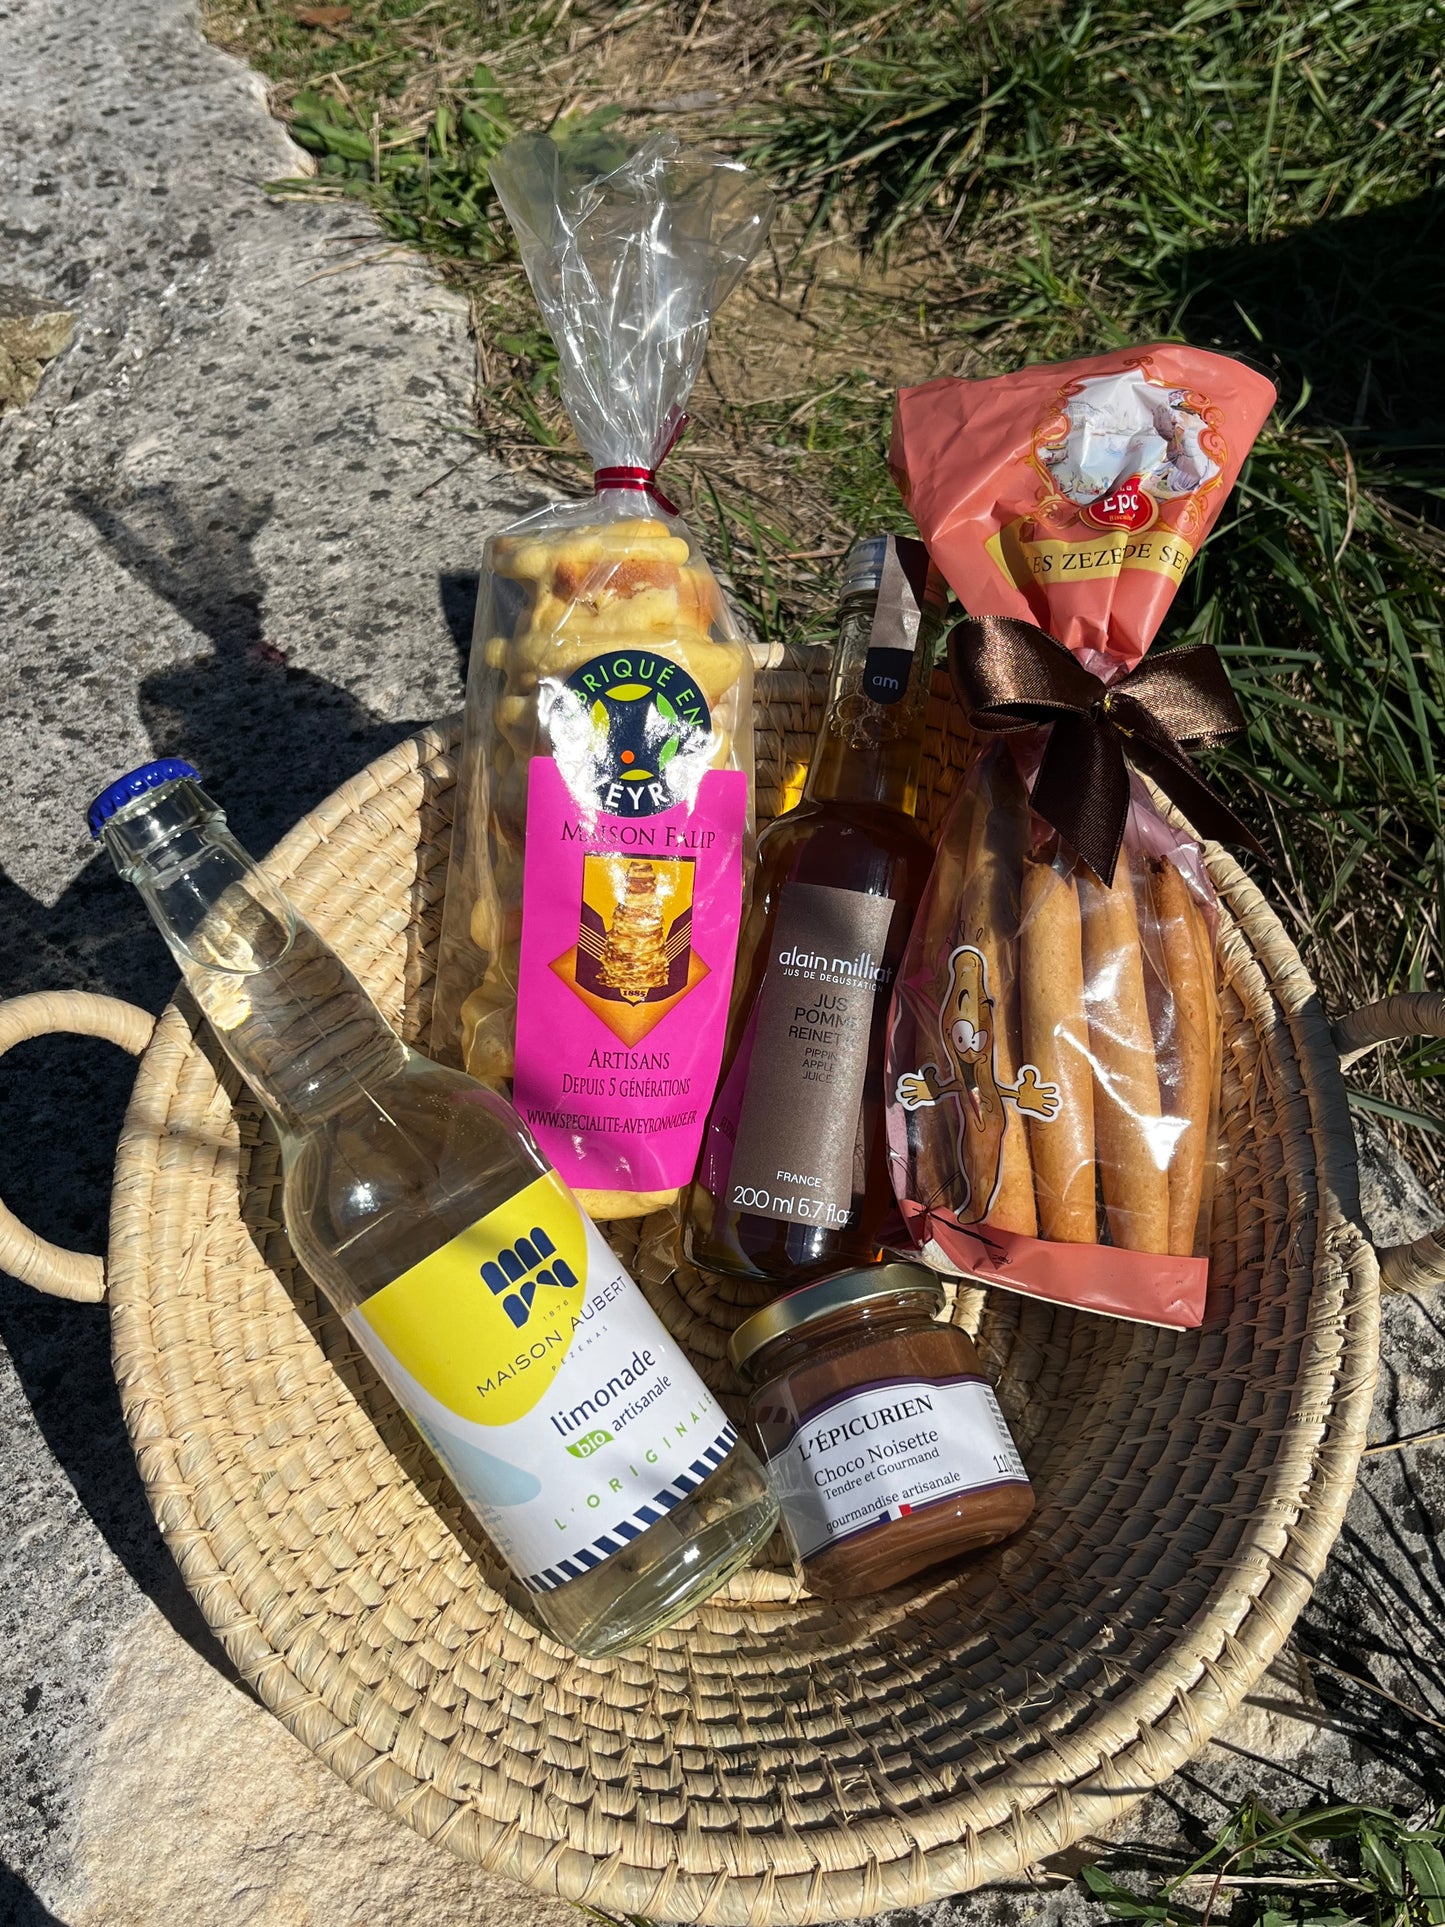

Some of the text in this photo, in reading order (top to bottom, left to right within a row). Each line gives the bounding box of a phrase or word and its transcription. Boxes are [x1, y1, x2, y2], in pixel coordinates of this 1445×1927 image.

[1027, 555, 1053, 574] ES
[1062, 547, 1124, 571] ZEZE
[1123, 543, 1152, 559] DE
[572, 658, 704, 726] BRIQUÉ EN
[872, 674, 899, 690] am
[665, 826, 716, 849] FALIP
[779, 945, 893, 984] alain milliat
[783, 968, 884, 992] JUS DE DEGUSTATION
[622, 990, 646, 998] 1885
[813, 993, 848, 1012] JUS
[587, 1048, 670, 1070] ARTISANS
[802, 1059, 834, 1073] APPLE
[805, 1047, 838, 1061] PIPPIN
[562, 1073, 691, 1098] DEPUIS 5 GÉNÉRATIONS
[803, 1071, 834, 1084] JUICE
[776, 1170, 822, 1187] FRANCE
[733, 1185, 770, 1209] 200
[772, 1196, 795, 1214] ml
[797, 1198, 824, 1219] 6.7
[476, 1275, 628, 1398] MAISON AUBERT
[550, 1349, 656, 1437] limonade
[576, 1374, 672, 1458] bio artisanale
[798, 1394, 935, 1462] L'ÉPICURIEN
[554, 1392, 712, 1531] L'ORIGINALE
[814, 1428, 939, 1487] Choco Noisette
[823, 1447, 940, 1500] Tendre et Gourmand
[826, 1471, 961, 1534] gourmandise artisanale
